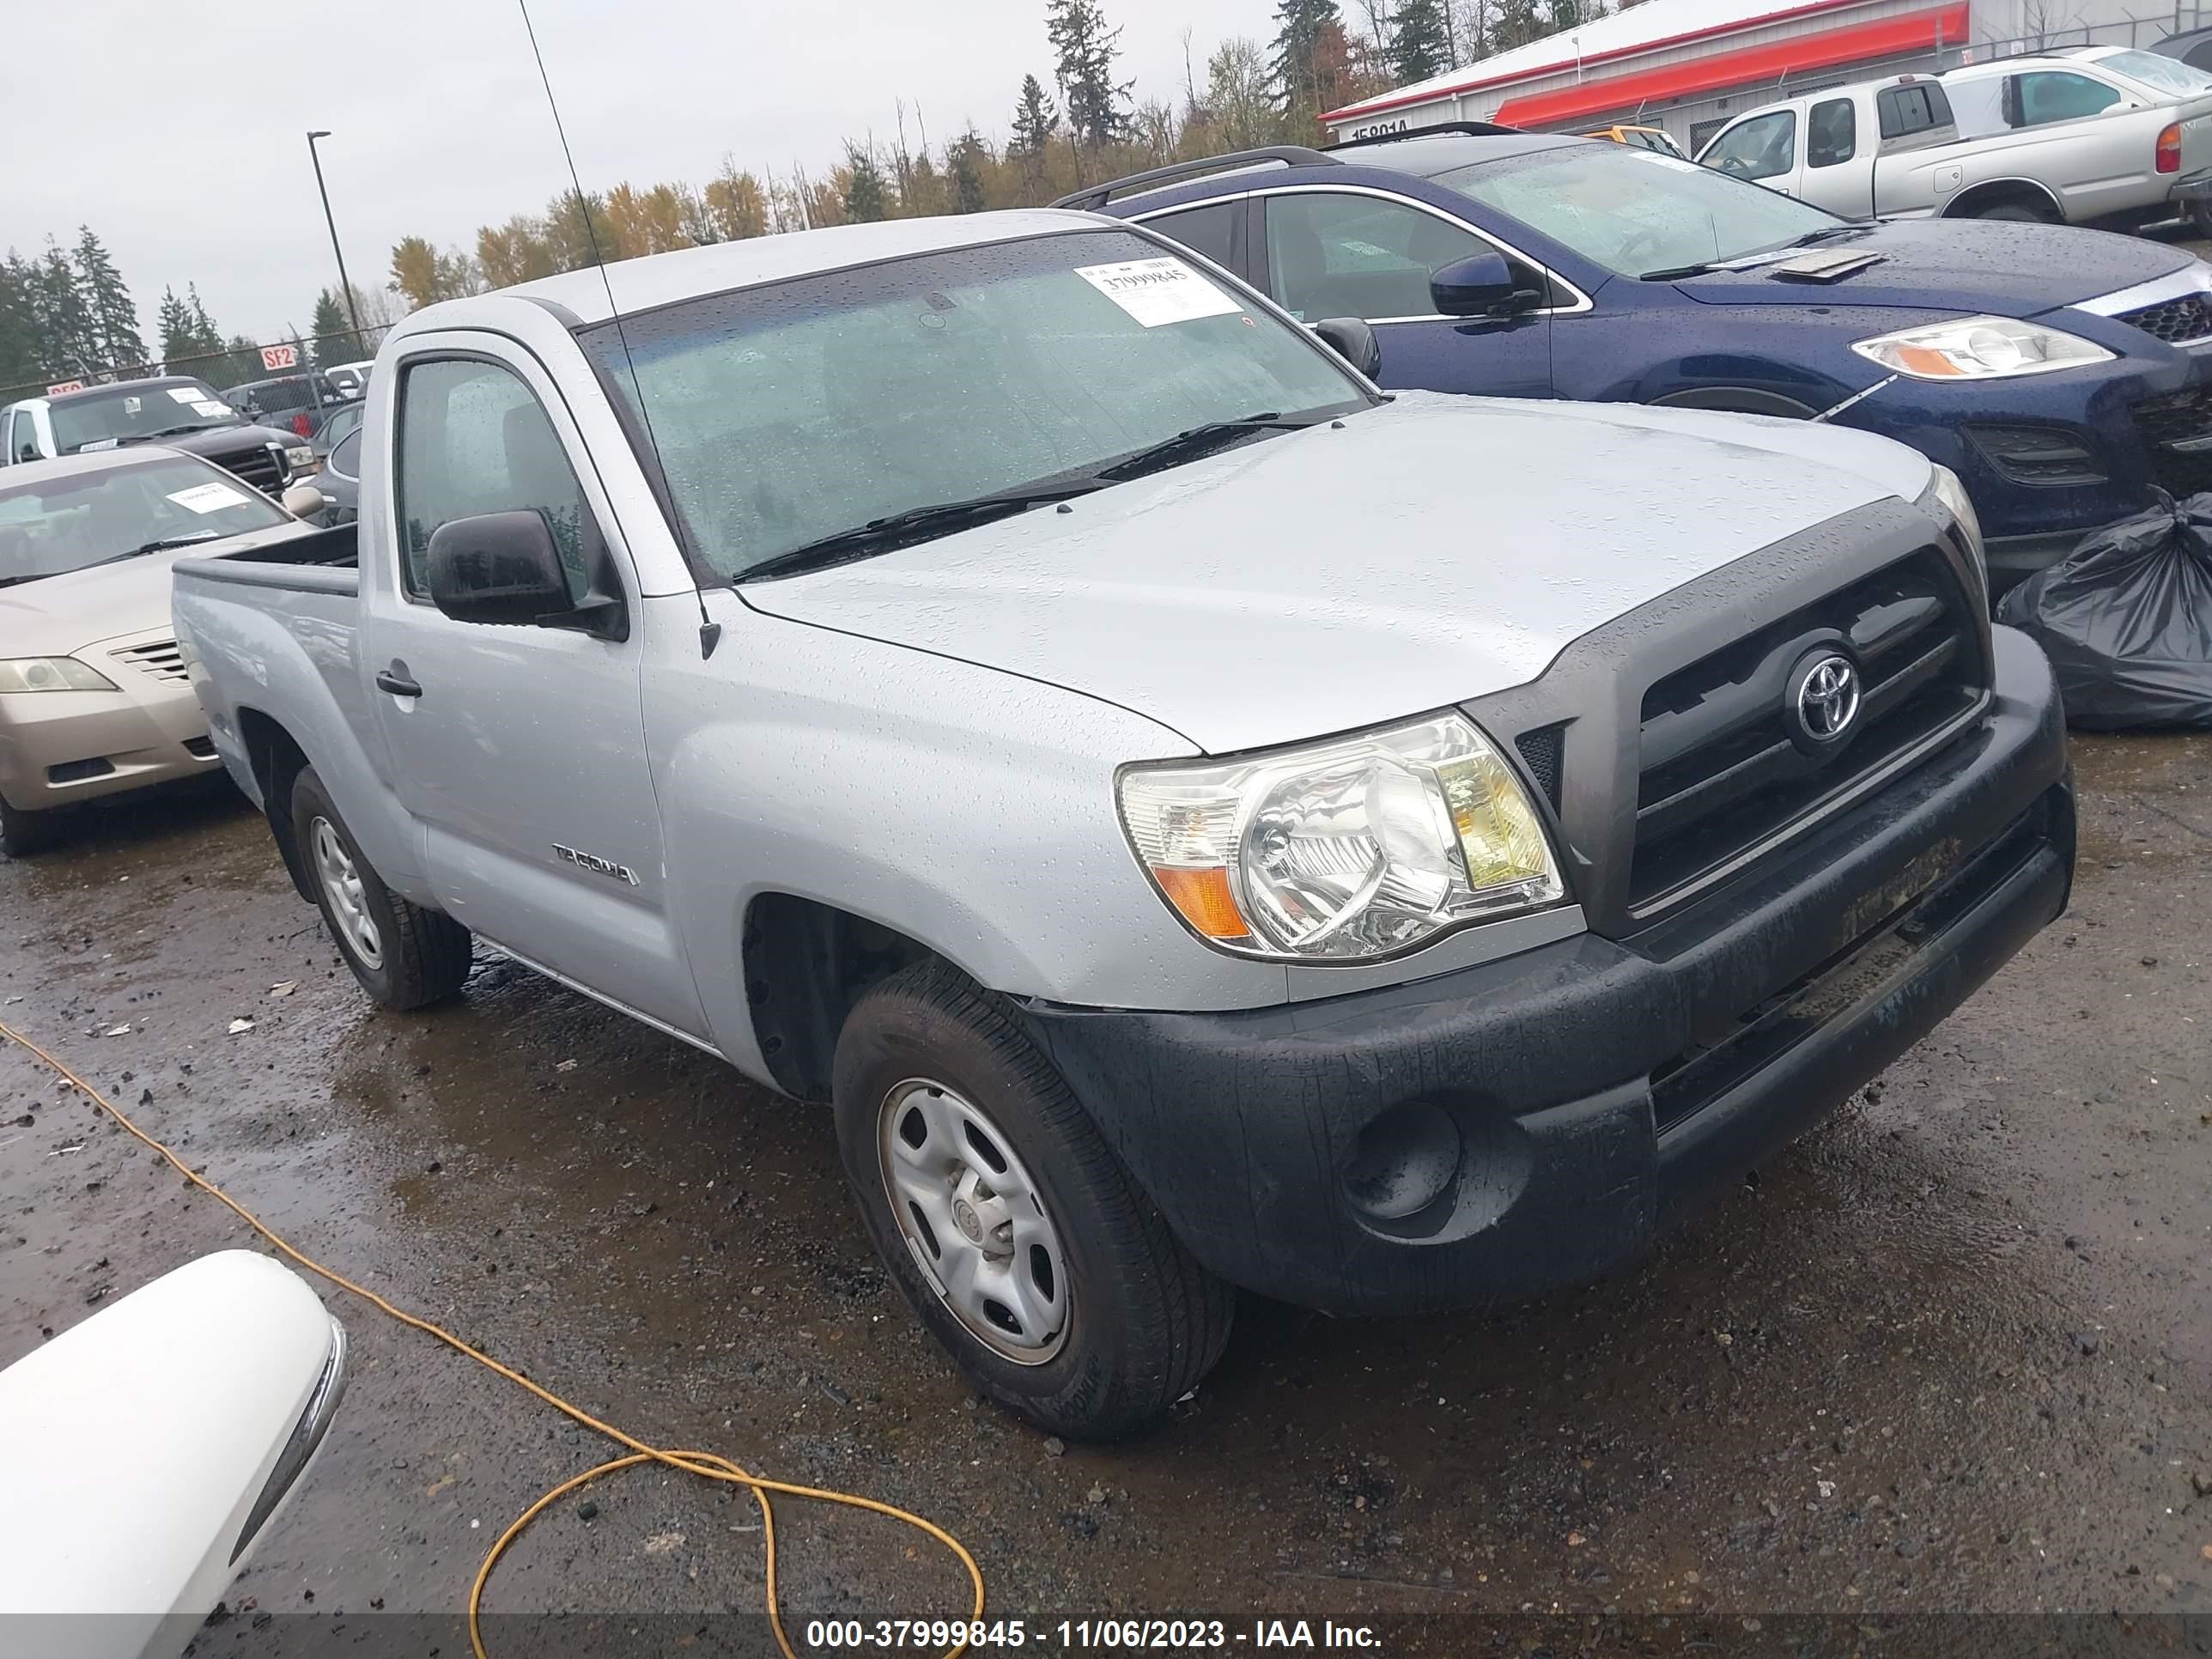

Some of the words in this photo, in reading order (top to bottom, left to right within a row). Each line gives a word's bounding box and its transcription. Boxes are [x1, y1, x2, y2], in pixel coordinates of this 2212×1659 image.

[1103, 270, 1188, 290] 37999845
[264, 348, 294, 368] SF2
[551, 842, 641, 886] TACOMA
